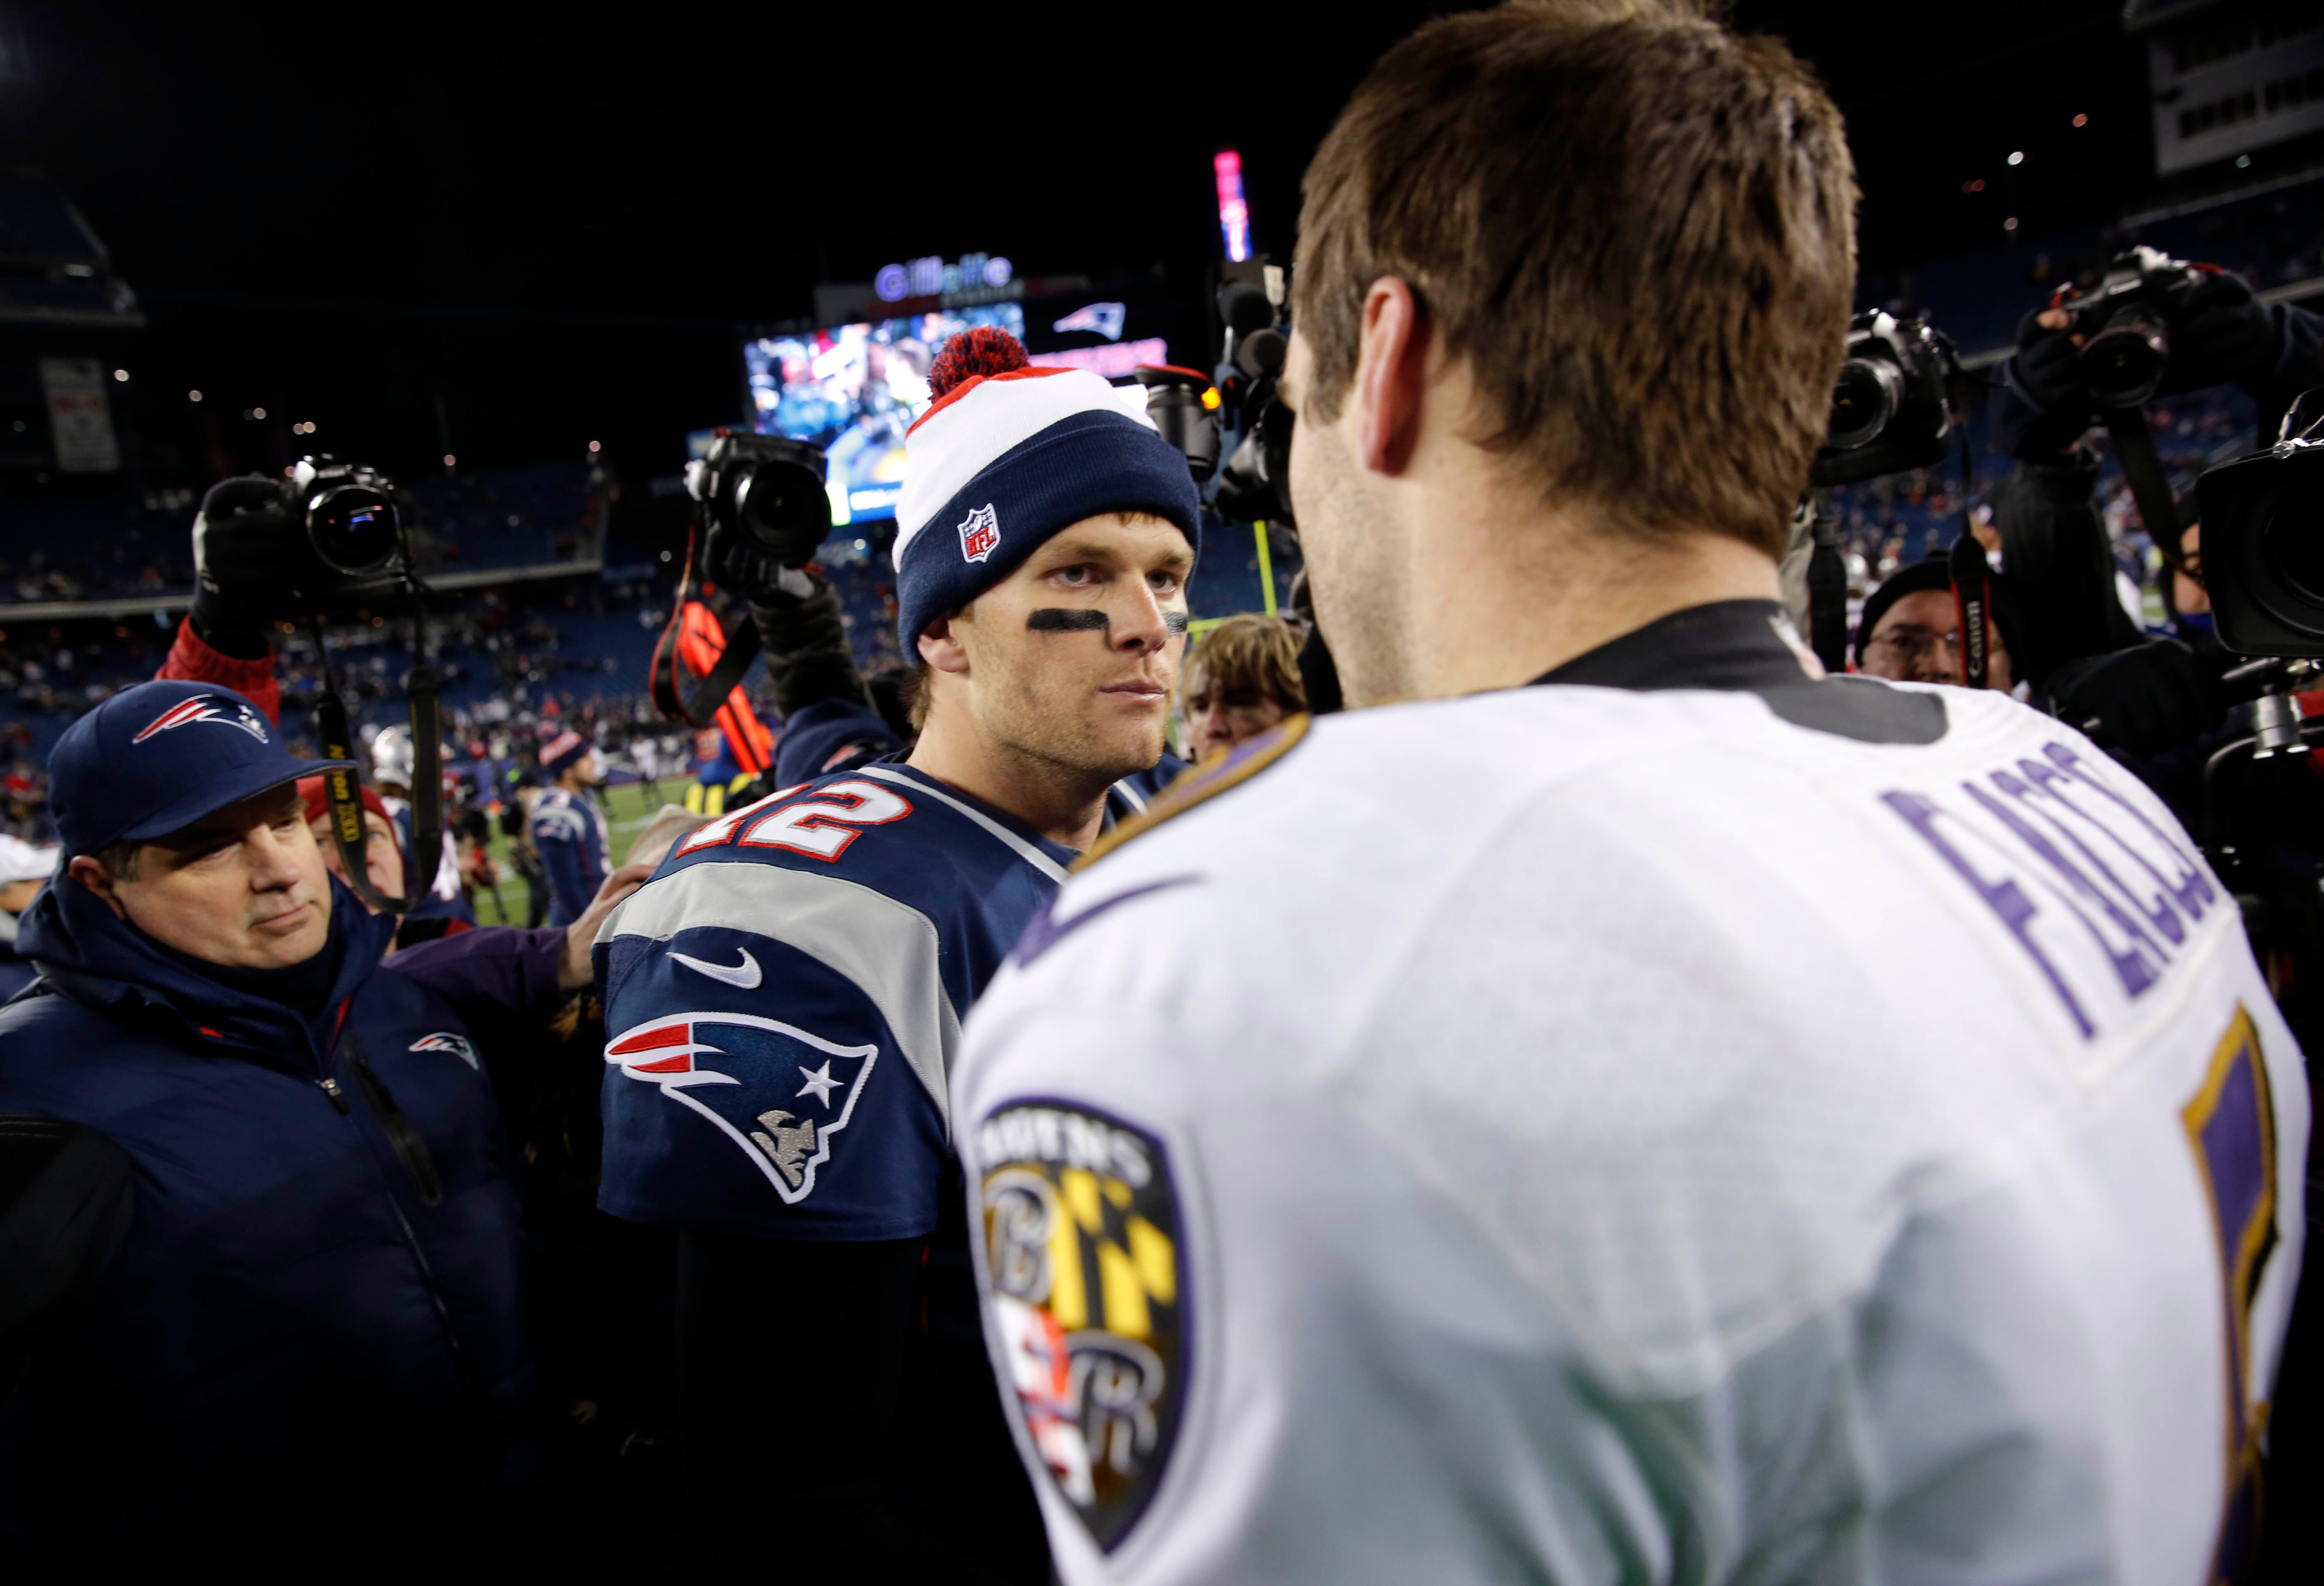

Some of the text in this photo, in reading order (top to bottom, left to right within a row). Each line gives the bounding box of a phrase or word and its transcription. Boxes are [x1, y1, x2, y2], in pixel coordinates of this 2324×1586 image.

[966, 527, 996, 556] NFL
[1967, 600, 1983, 678] Canon
[328, 743, 349, 800] Non
[675, 780, 914, 864] 12
